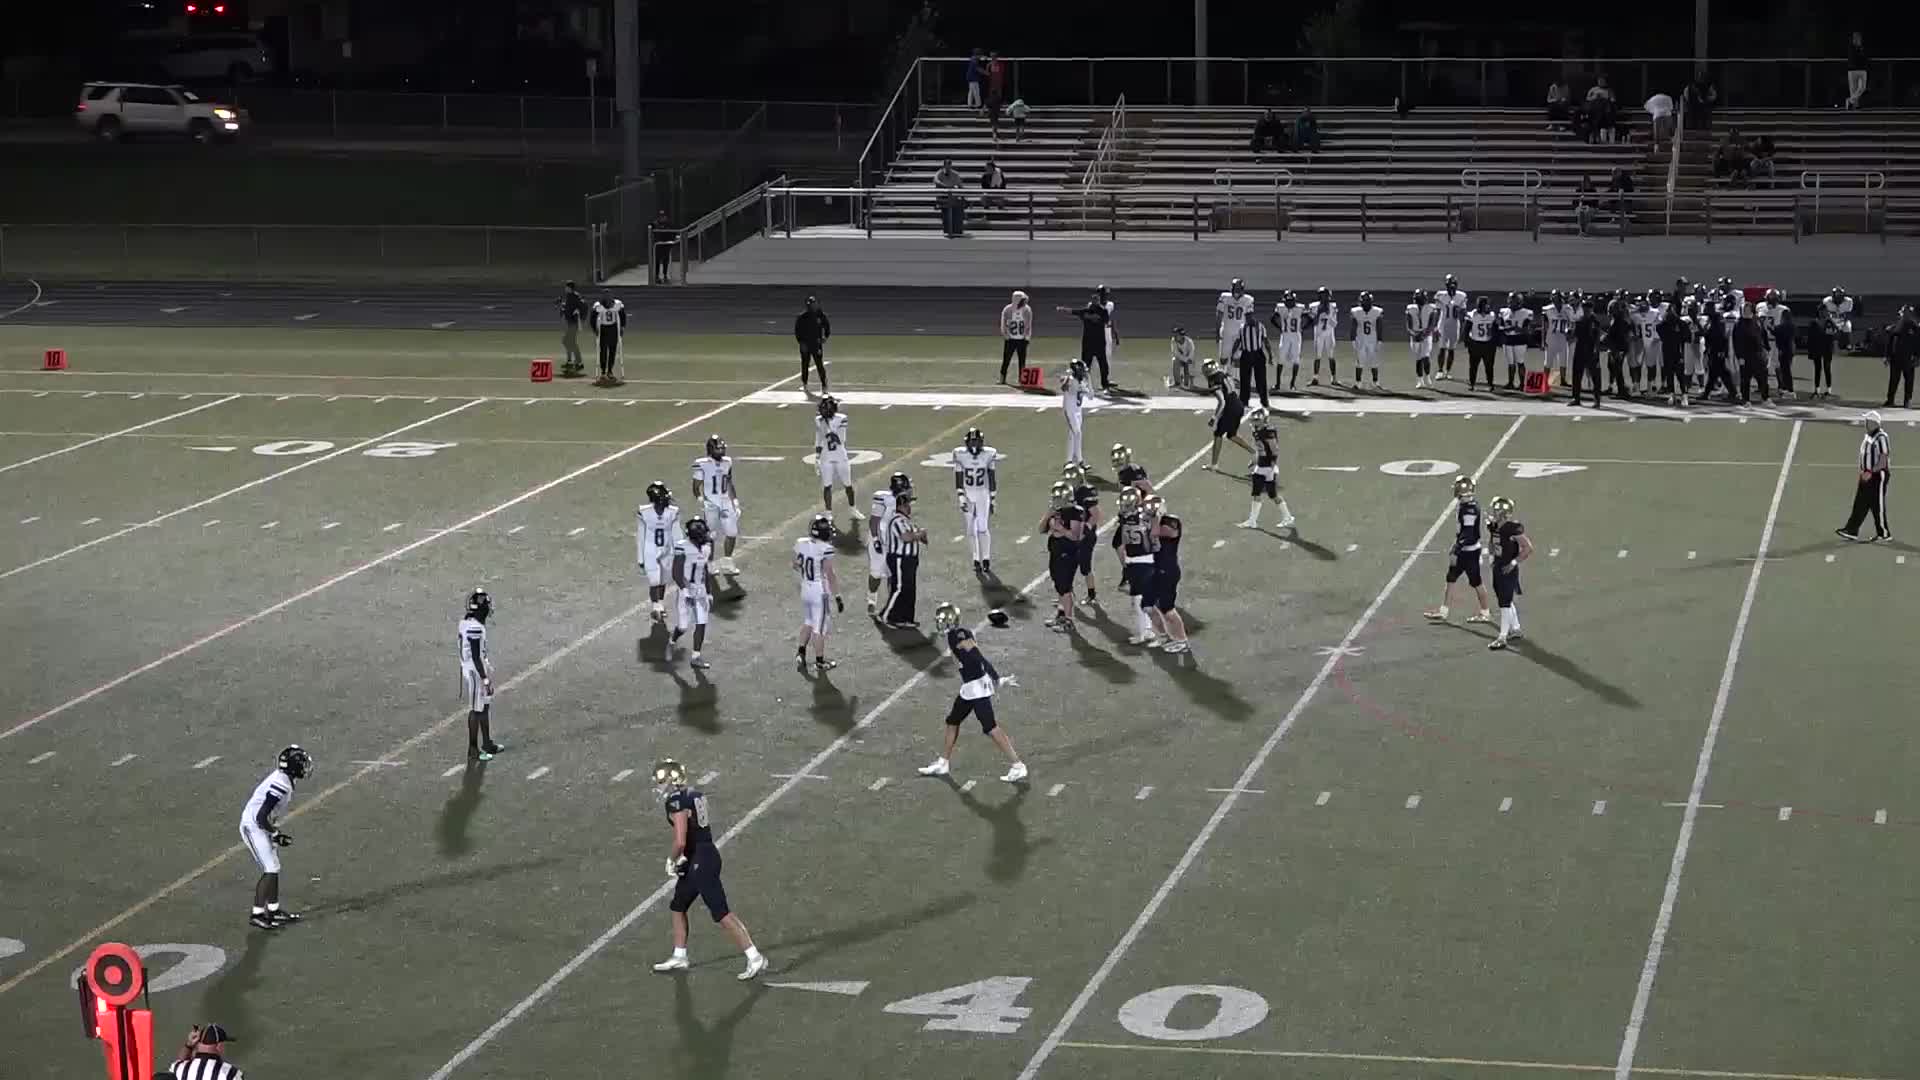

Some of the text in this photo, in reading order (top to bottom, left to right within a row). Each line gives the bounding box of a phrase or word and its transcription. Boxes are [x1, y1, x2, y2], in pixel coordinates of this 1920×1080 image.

[1227, 304, 1243, 321] 50
[1009, 320, 1025, 336] 28
[1283, 317, 1298, 333] 19
[1320, 318, 1329, 331] 7
[1363, 320, 1371, 336] 6
[531, 361, 549, 378] 20
[1021, 368, 1040, 385] 30
[711, 474, 730, 495] 10
[964, 467, 986, 487] 52
[654, 528, 665, 547] 8
[882, 975, 1270, 1041] 40
